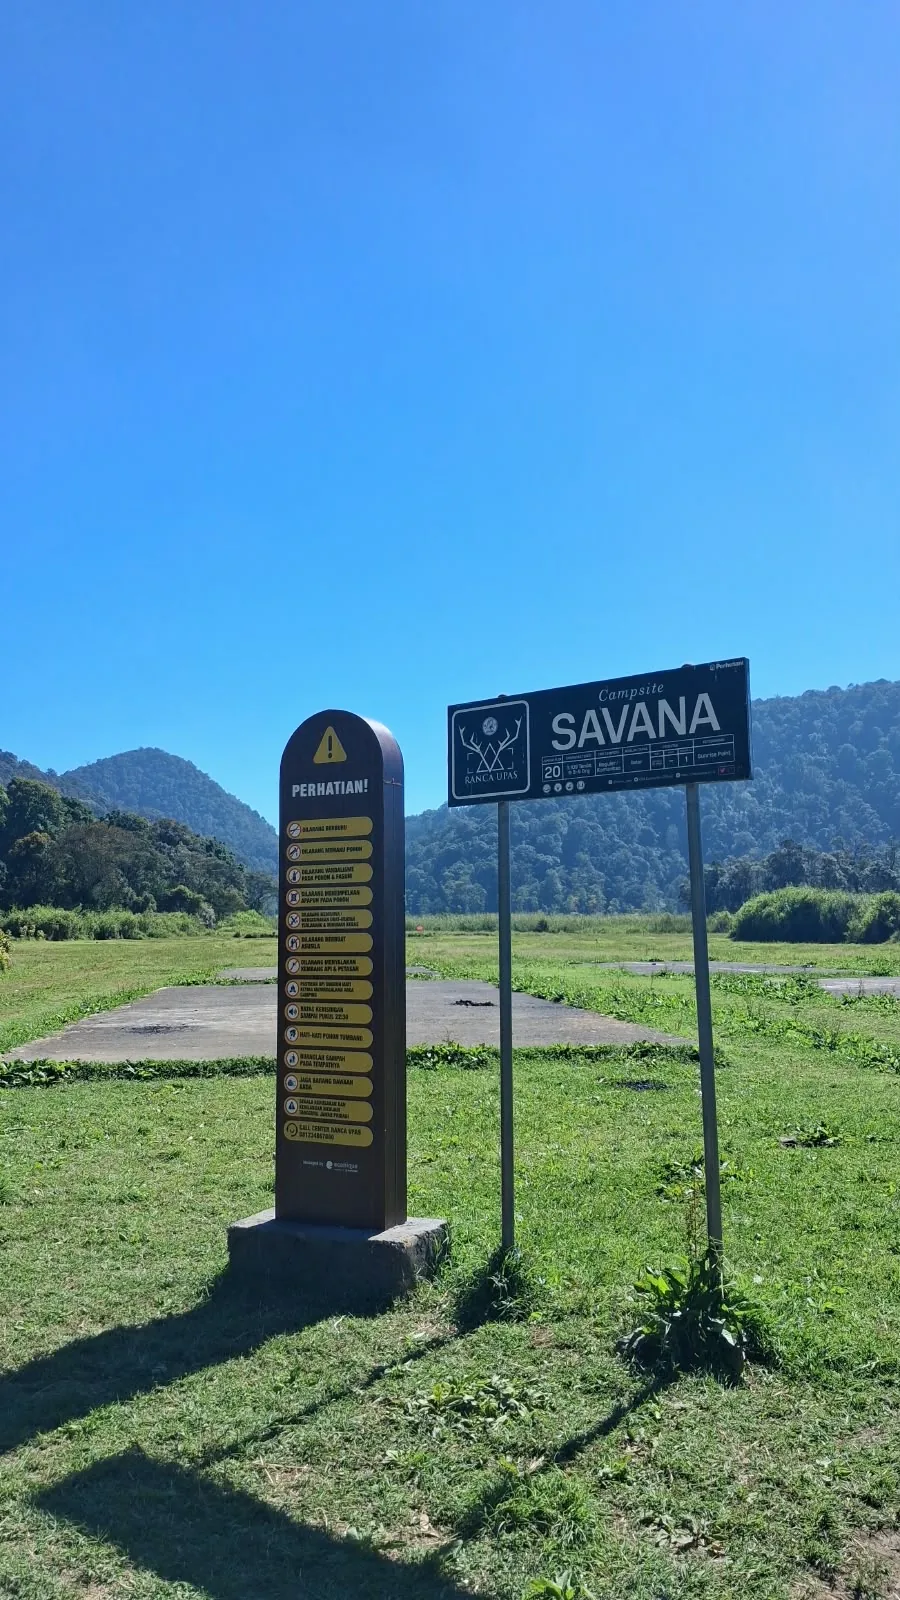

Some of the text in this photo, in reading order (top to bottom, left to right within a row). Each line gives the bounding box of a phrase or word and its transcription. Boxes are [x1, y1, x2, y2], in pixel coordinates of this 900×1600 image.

[598, 682, 664, 702] Campsite
[552, 692, 721, 750] SAVANA
[465, 771, 518, 784] RANCA UPAS
[544, 766, 560, 778] 20
[292, 779, 368, 797] PERHATIAN!
